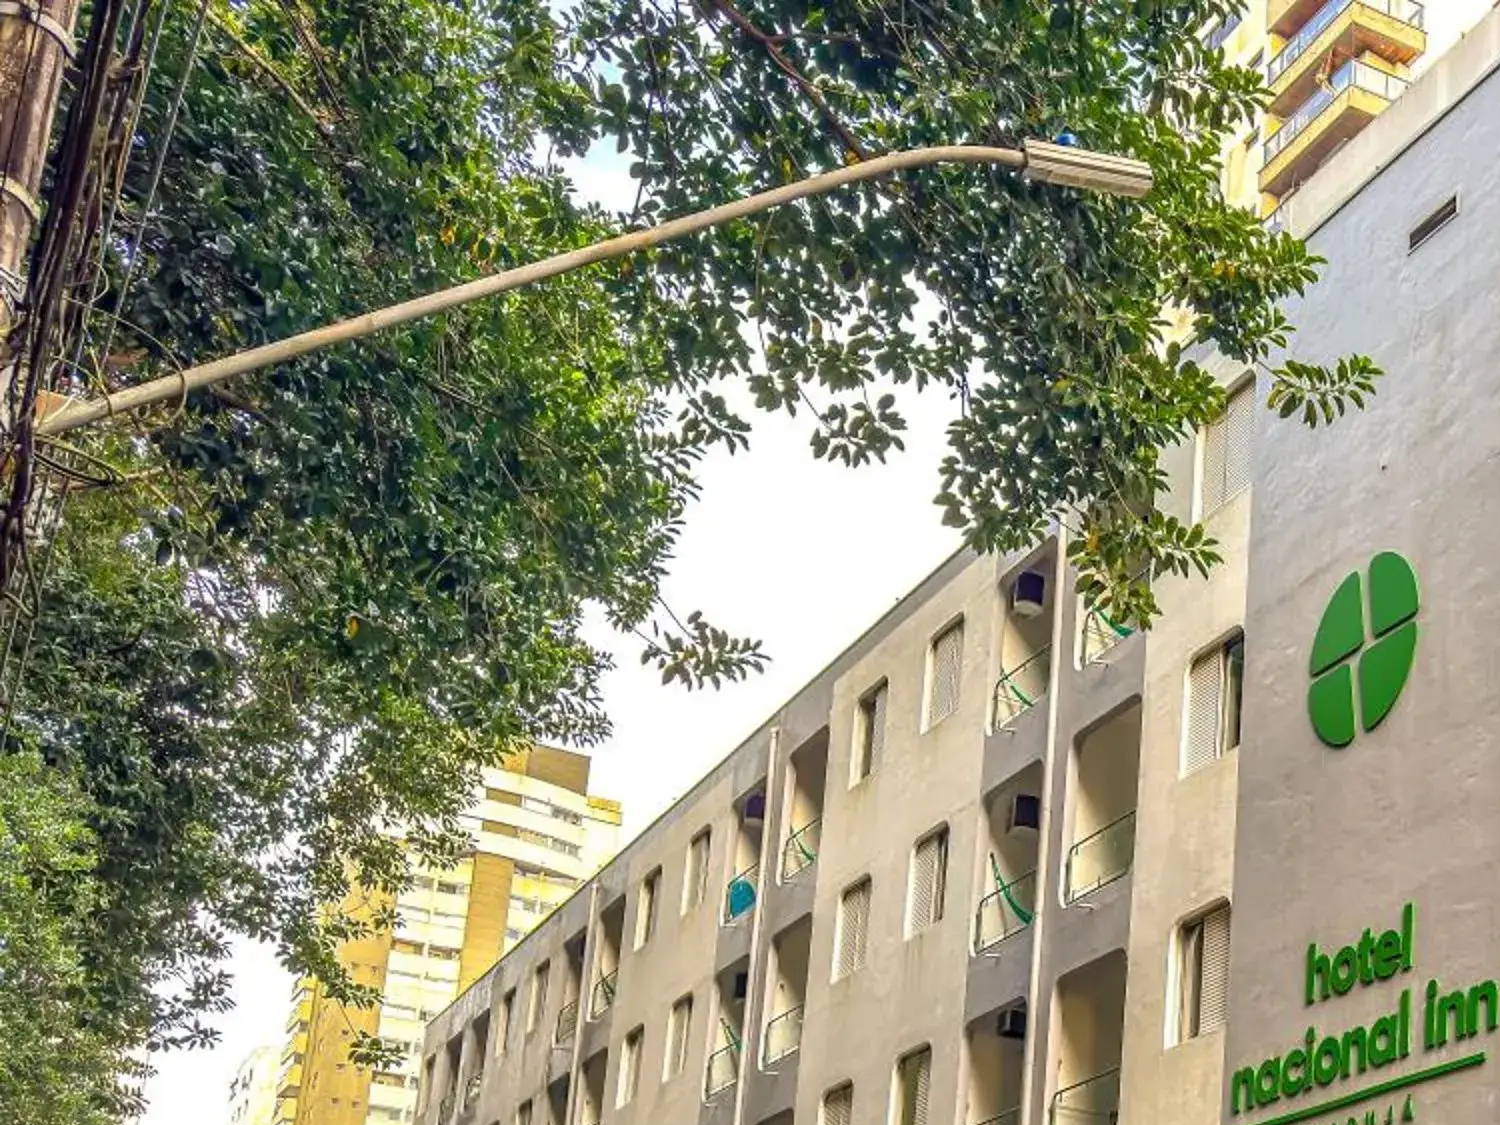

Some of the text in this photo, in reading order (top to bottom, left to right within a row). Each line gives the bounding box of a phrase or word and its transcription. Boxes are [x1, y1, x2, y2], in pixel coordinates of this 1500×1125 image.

[1305, 901, 1415, 1007] hotel
[1231, 978, 1500, 1116] nacional inn
